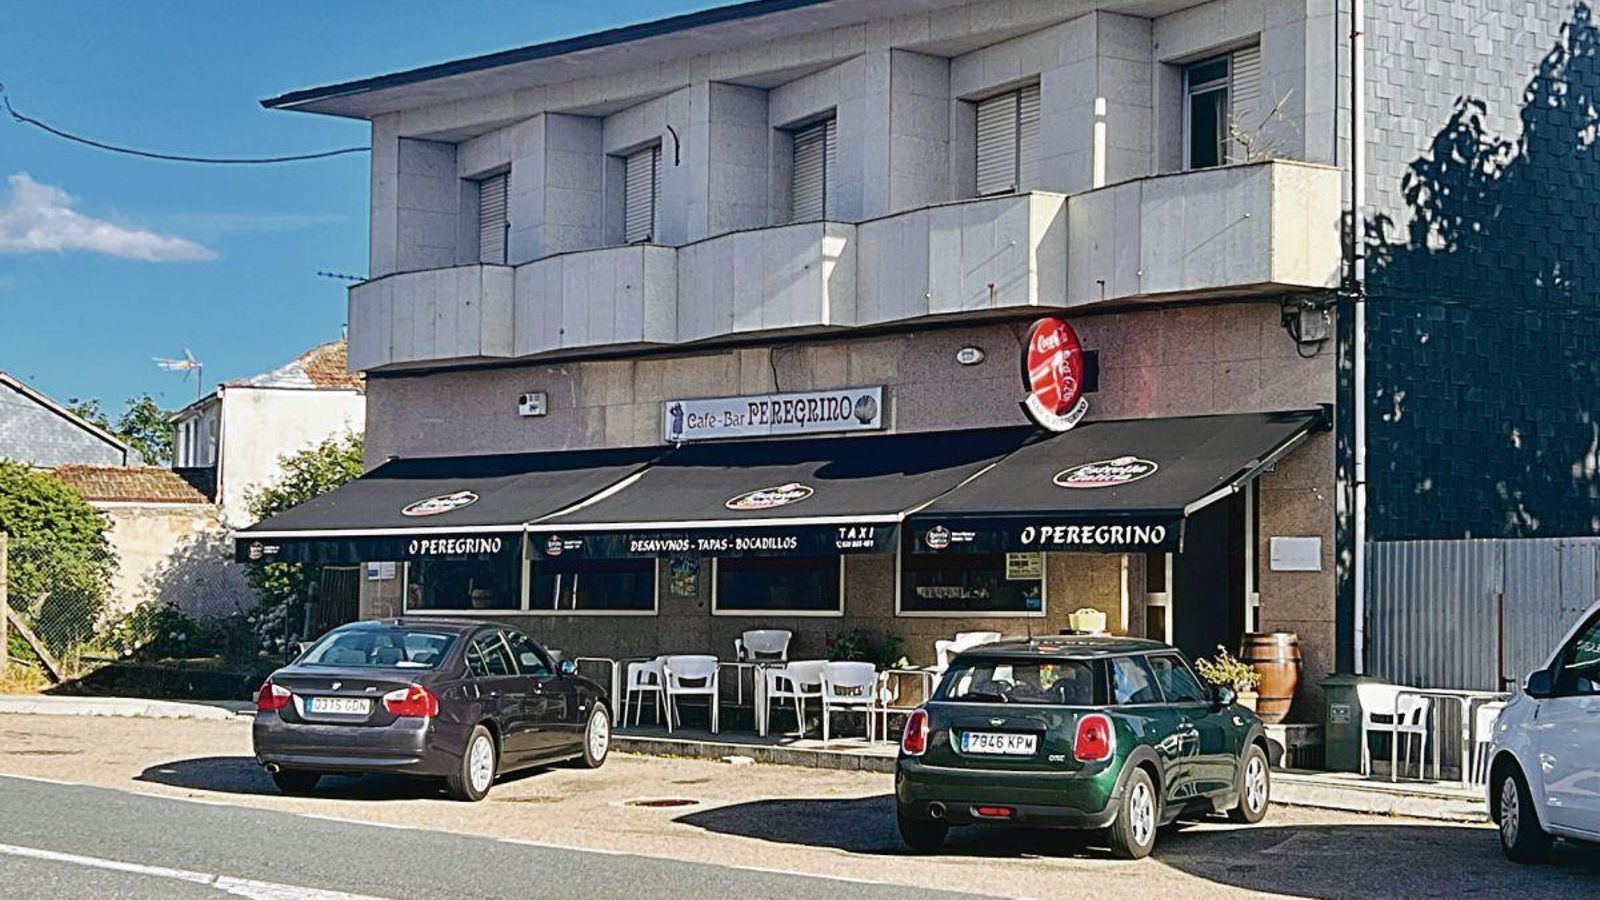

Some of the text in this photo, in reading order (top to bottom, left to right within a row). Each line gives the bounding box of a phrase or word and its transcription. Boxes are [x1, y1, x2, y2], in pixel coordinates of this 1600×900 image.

[747, 395, 853, 428] PEREGRINO
[838, 526, 874, 540] TAXI
[1020, 525, 1166, 545] O PEREGRINO
[409, 537, 502, 555] O PEREGRINO
[697, 538, 728, 551] TAPAS
[735, 536, 797, 550] BOCADILLOS
[971, 734, 1034, 749] 7946 KPM
